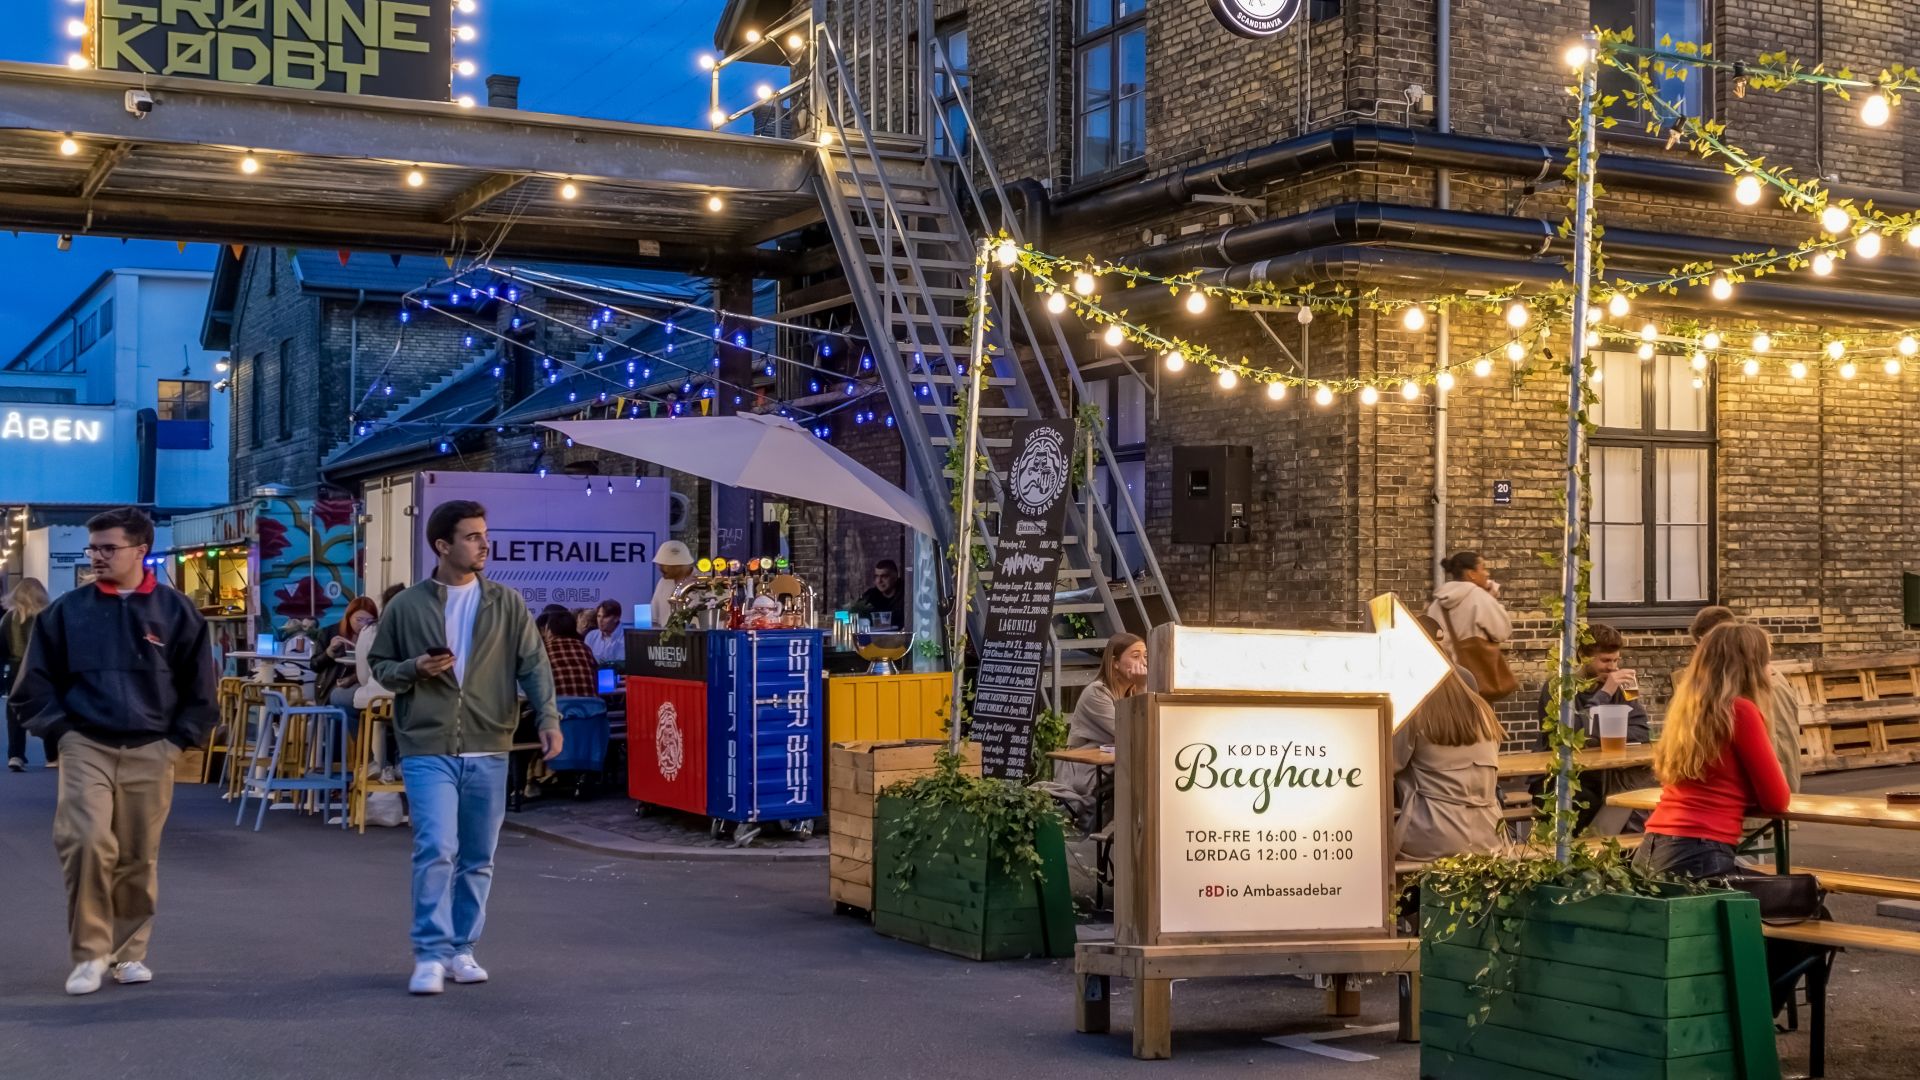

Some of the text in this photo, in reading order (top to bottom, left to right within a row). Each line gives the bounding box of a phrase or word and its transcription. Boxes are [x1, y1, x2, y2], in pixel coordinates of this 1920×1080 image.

[1236, 11, 1283, 30] SCANDINAVIA
[101, 17, 379, 95] KØDBY
[2, 411, 101, 441] ÅBEN
[1025, 426, 1064, 447] ARTSPACE
[1497, 483, 1509, 493] 20
[1016, 500, 1054, 517] BEER BAR
[488, 540, 646, 563] LETRAILER
[514, 587, 600, 603] DE GREJ
[998, 619, 1037, 633] LAGUNITAS
[787, 639, 809, 728] BETTER
[1228, 744, 1326, 757] KØDBYENS
[786, 735, 808, 804] BEER
[1174, 741, 1364, 814] Baghave
[1186, 830, 1251, 843] TOR-FRE
[1257, 830, 1297, 842] 16:00
[1313, 830, 1353, 842] 01:00
[1186, 849, 1251, 862] LØRDAG
[1257, 849, 1297, 861] 12:00
[1313, 848, 1353, 861] 01:00
[1199, 883, 1342, 898] r8Dio Ambassadebar
